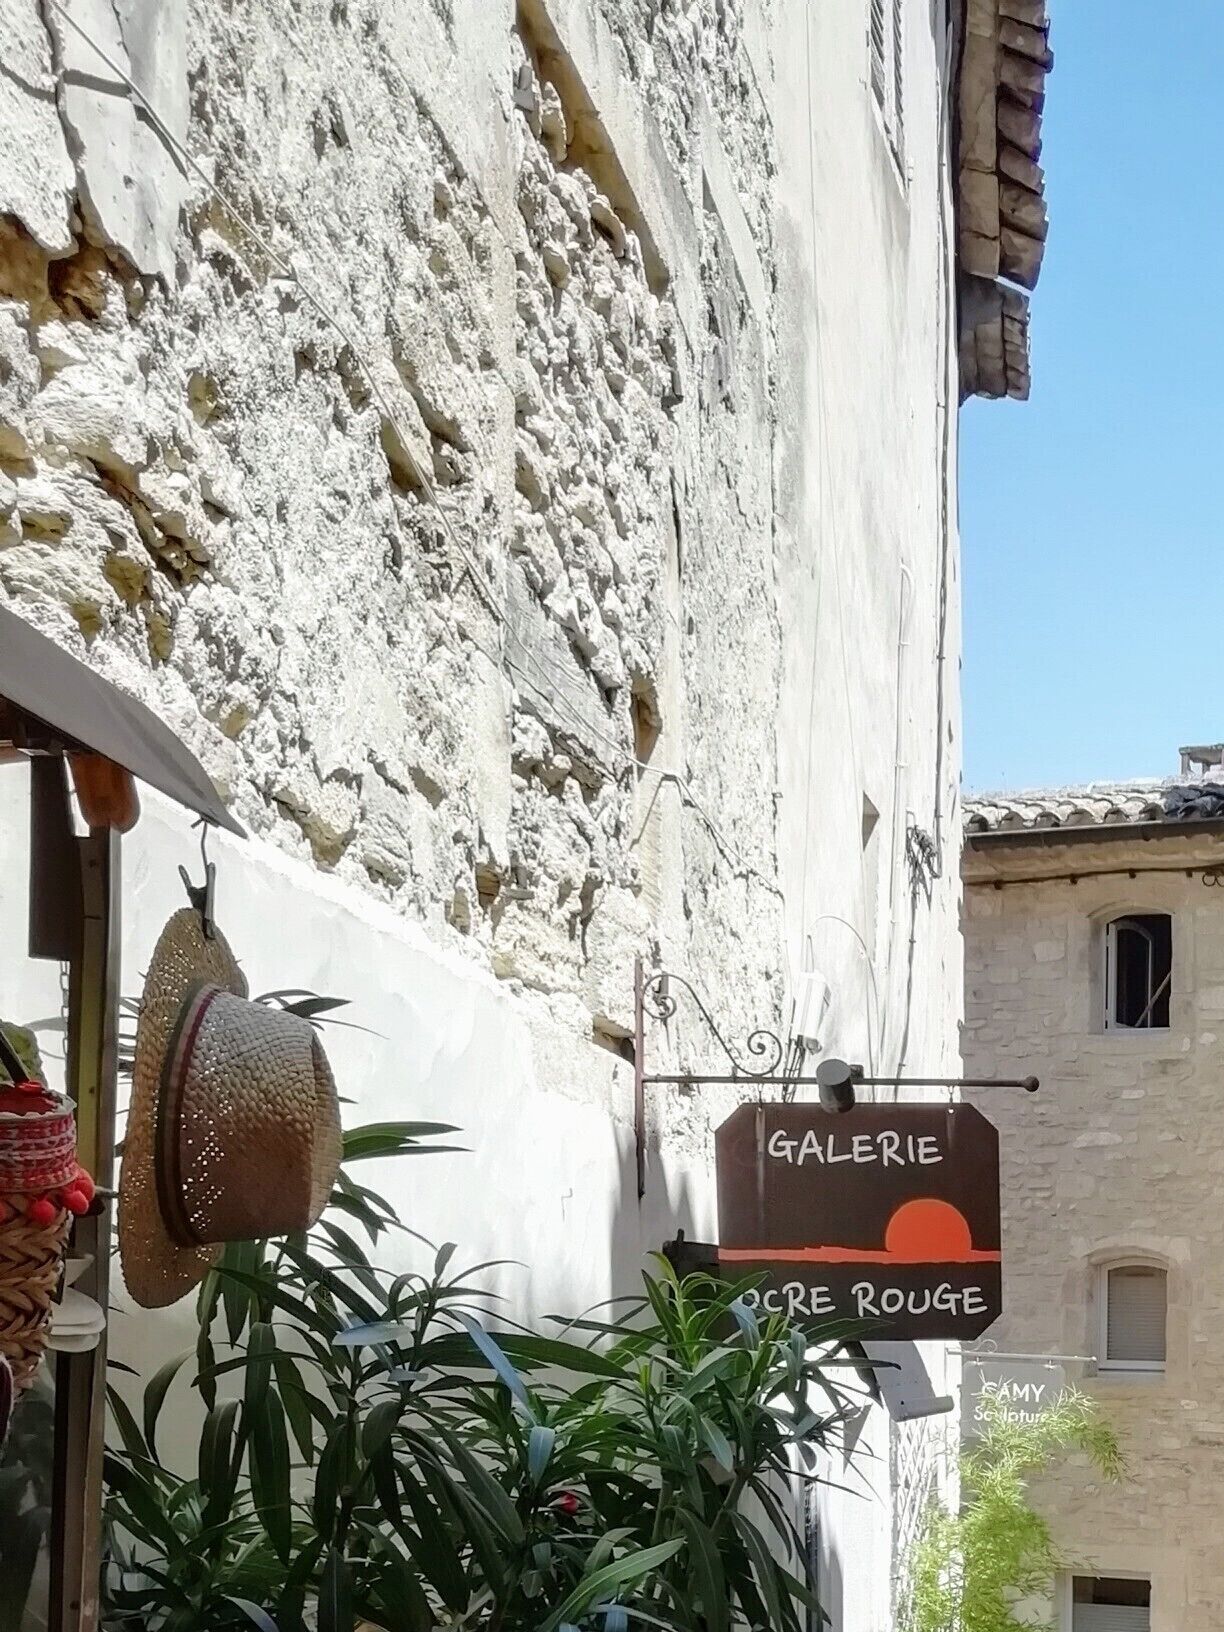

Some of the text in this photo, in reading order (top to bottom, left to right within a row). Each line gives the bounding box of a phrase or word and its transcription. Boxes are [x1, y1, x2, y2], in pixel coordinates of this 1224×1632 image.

[767, 1129, 944, 1167] GALERIE
[739, 1281, 988, 1318] OCRE ROUGE
